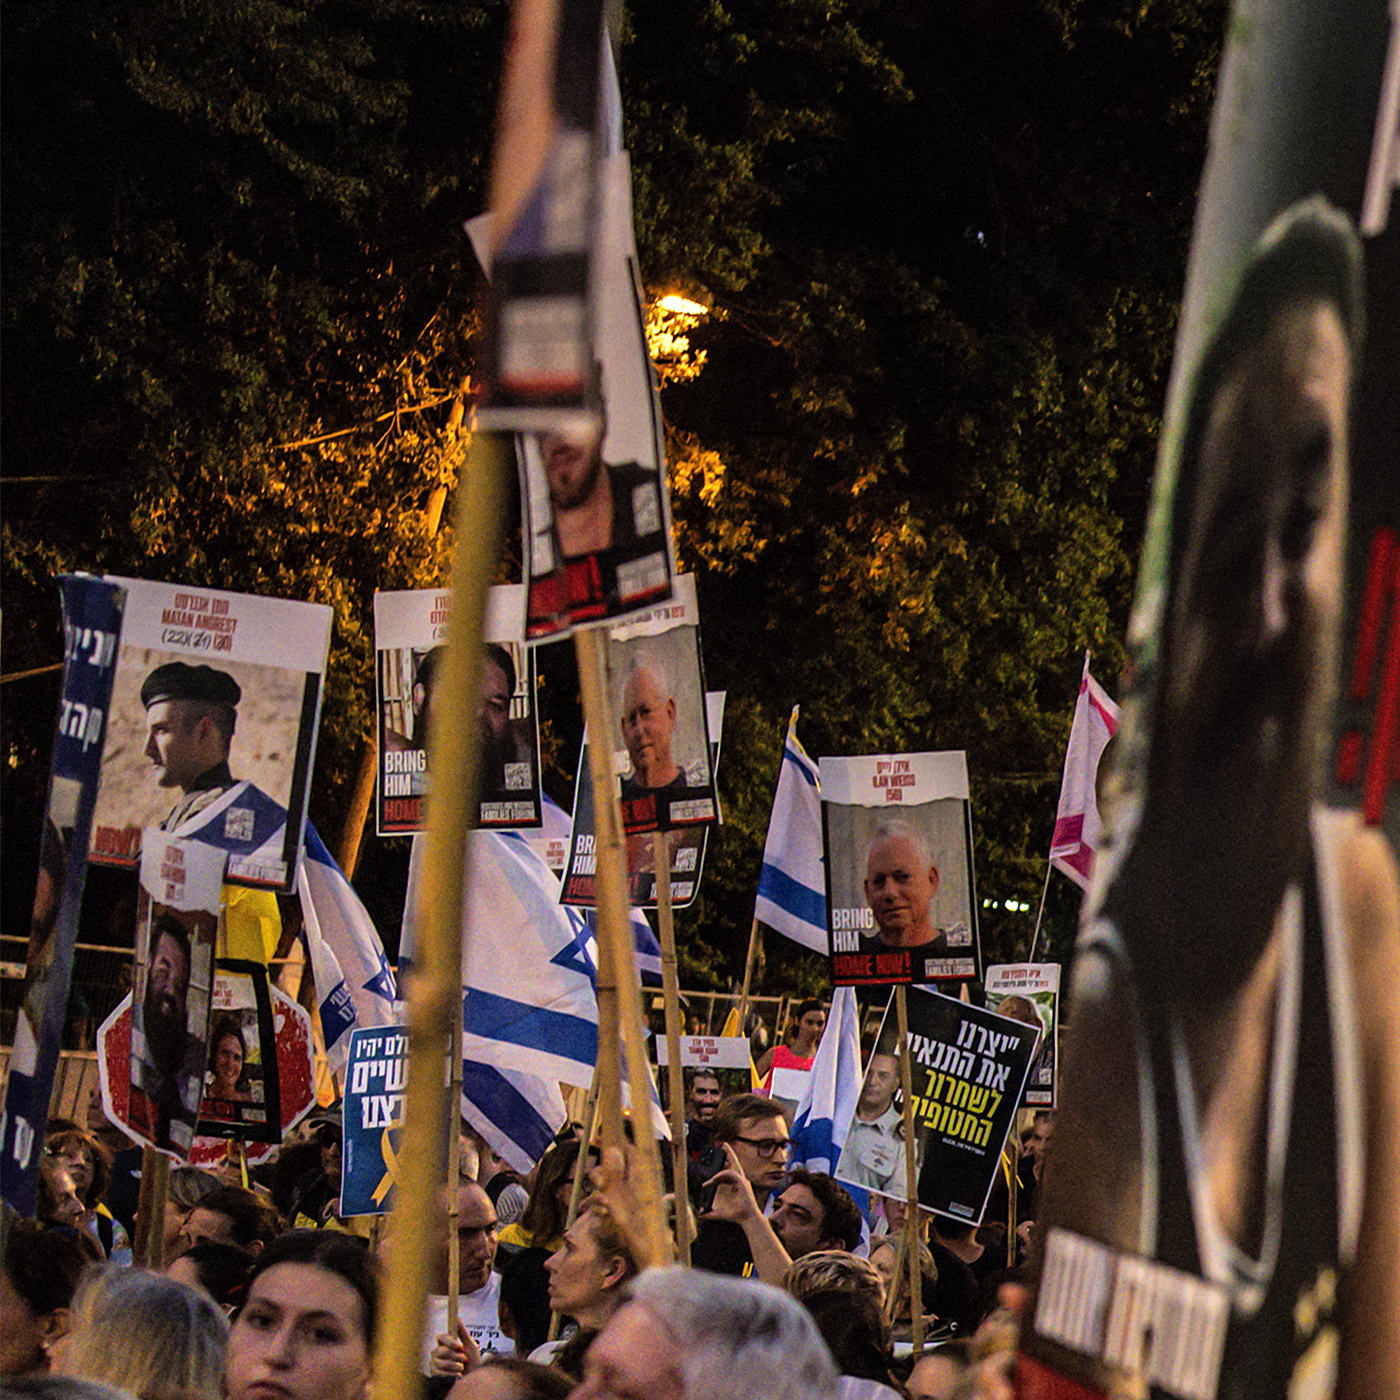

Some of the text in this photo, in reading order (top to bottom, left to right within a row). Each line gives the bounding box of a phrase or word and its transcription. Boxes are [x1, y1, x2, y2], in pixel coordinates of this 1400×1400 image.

[384, 749, 427, 773] BRING
[384, 774, 412, 796] HIM
[832, 908, 874, 930] BRING
[833, 931, 860, 952] HIM
[834, 954, 874, 976] HOME
[876, 951, 912, 975] NOW!
[356, 1037, 382, 1058] יהיו
[975, 1058, 1012, 1092] את
[925, 1069, 1003, 1119] לשחרור
